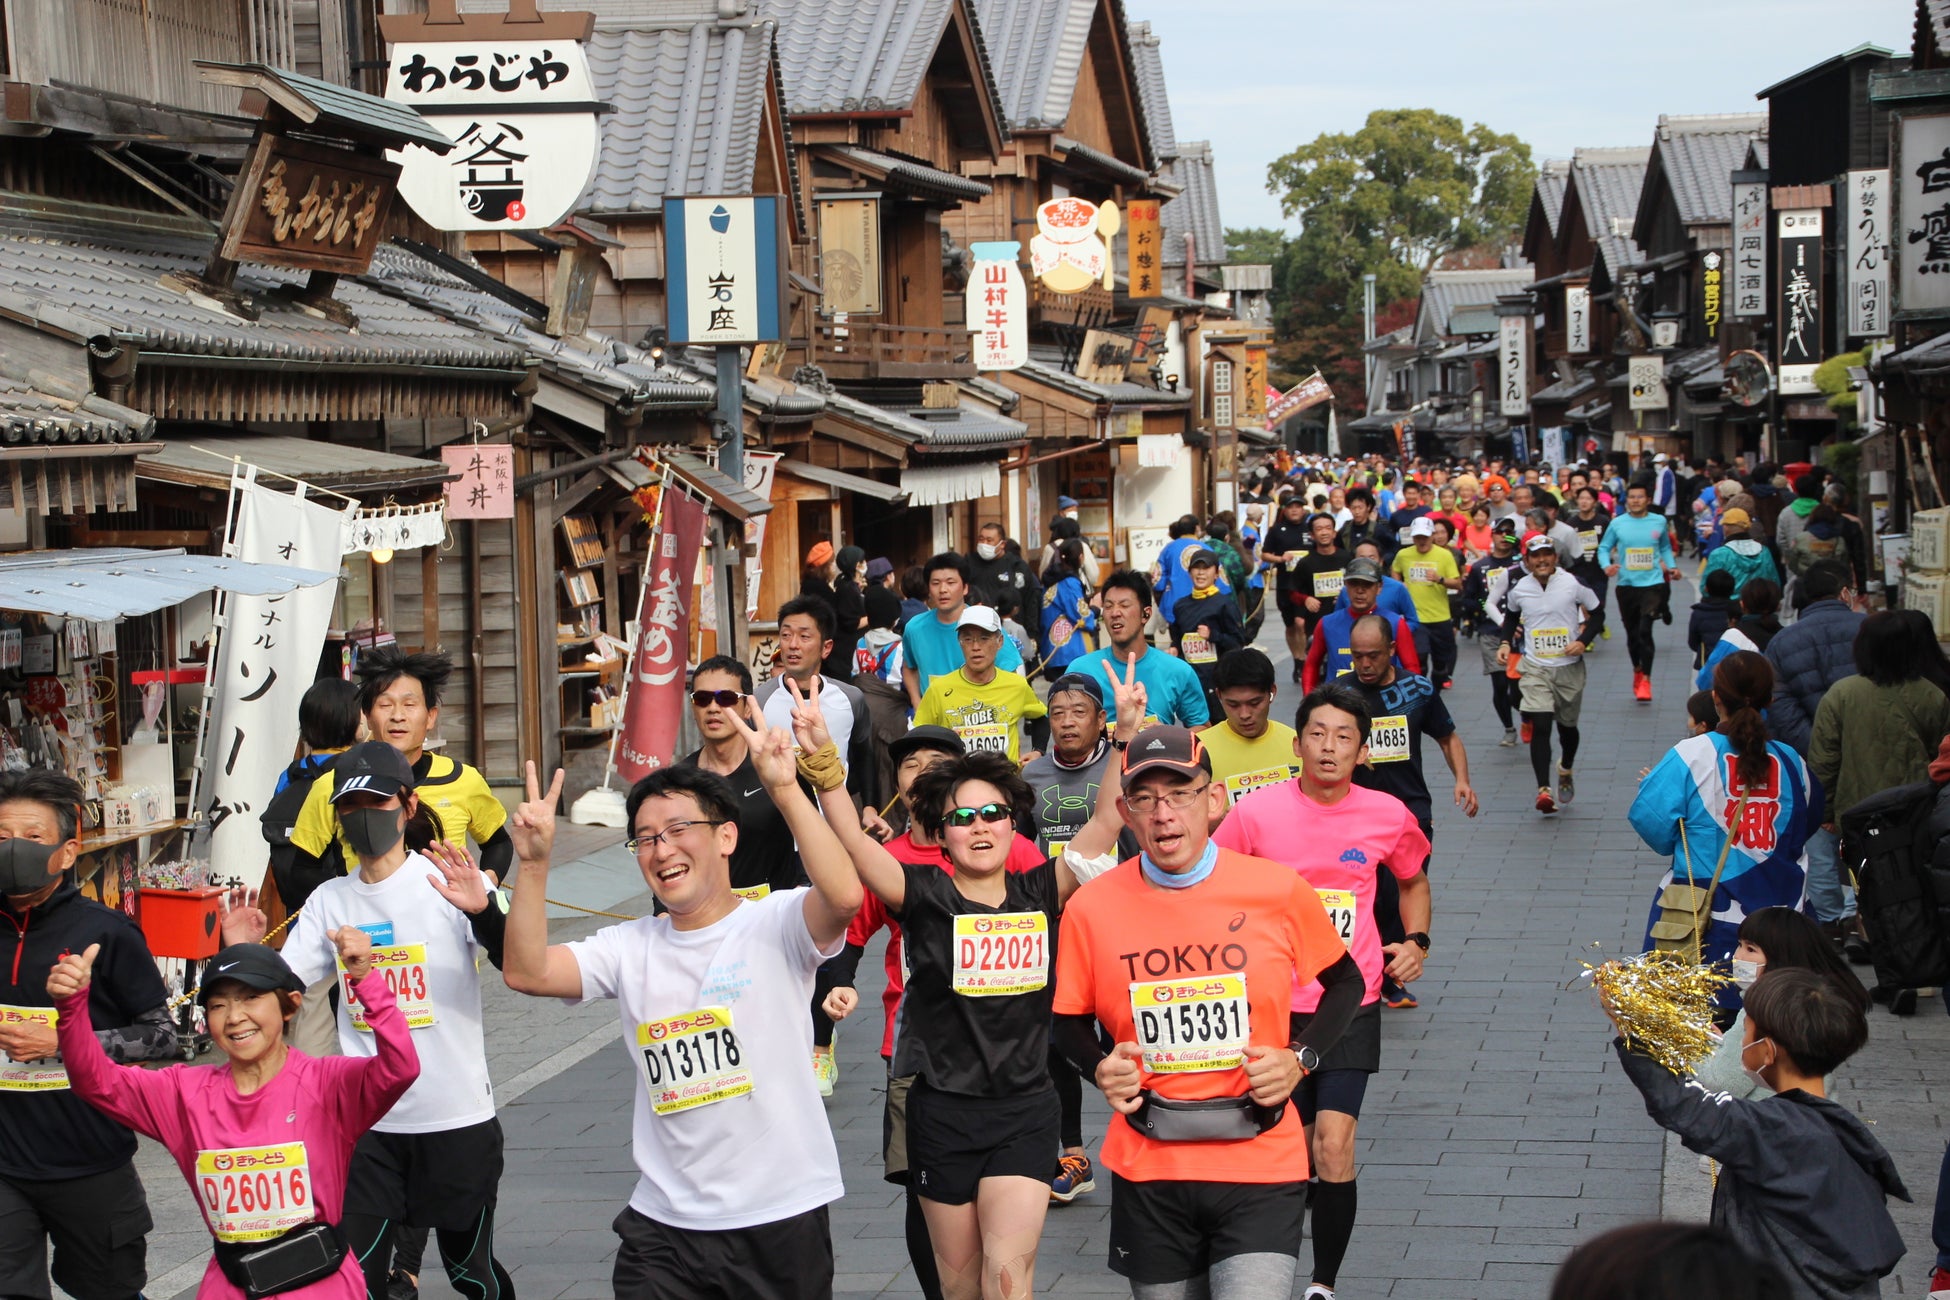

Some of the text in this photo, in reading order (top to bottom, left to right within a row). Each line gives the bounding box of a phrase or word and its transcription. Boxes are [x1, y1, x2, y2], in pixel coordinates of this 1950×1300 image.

[400, 49, 569, 92] わらじや
[863, 209, 872, 265] STARBUCKS
[1857, 175, 1881, 332] 伊勢うどん 岡田屋
[1740, 236, 1761, 310] 岡七酒店
[707, 270, 737, 332] 岩座
[985, 265, 1009, 350] 山村牛乳
[1704, 270, 1720, 338] 神宮サワー
[1783, 376, 1812, 386] 岡七商
[467, 453, 492, 510] 牛丼
[495, 453, 509, 494] 松阪牛
[639, 568, 686, 686] 釜めし
[1380, 674, 1434, 710] DES
[964, 709, 994, 727] KOBE
[1368, 728, 1407, 748] 14685
[961, 933, 1043, 970] D22021
[1120, 943, 1248, 981] TOKYO
[343, 966, 426, 1005] D043
[1020, 974, 1044, 983] docomo
[1141, 1000, 1241, 1045] D15331
[644, 1028, 740, 1085] D13178
[1215, 1048, 1242, 1057] docom
[35, 1072, 66, 1080] docomo
[715, 1074, 747, 1088] docomo
[203, 1168, 306, 1214] D26016
